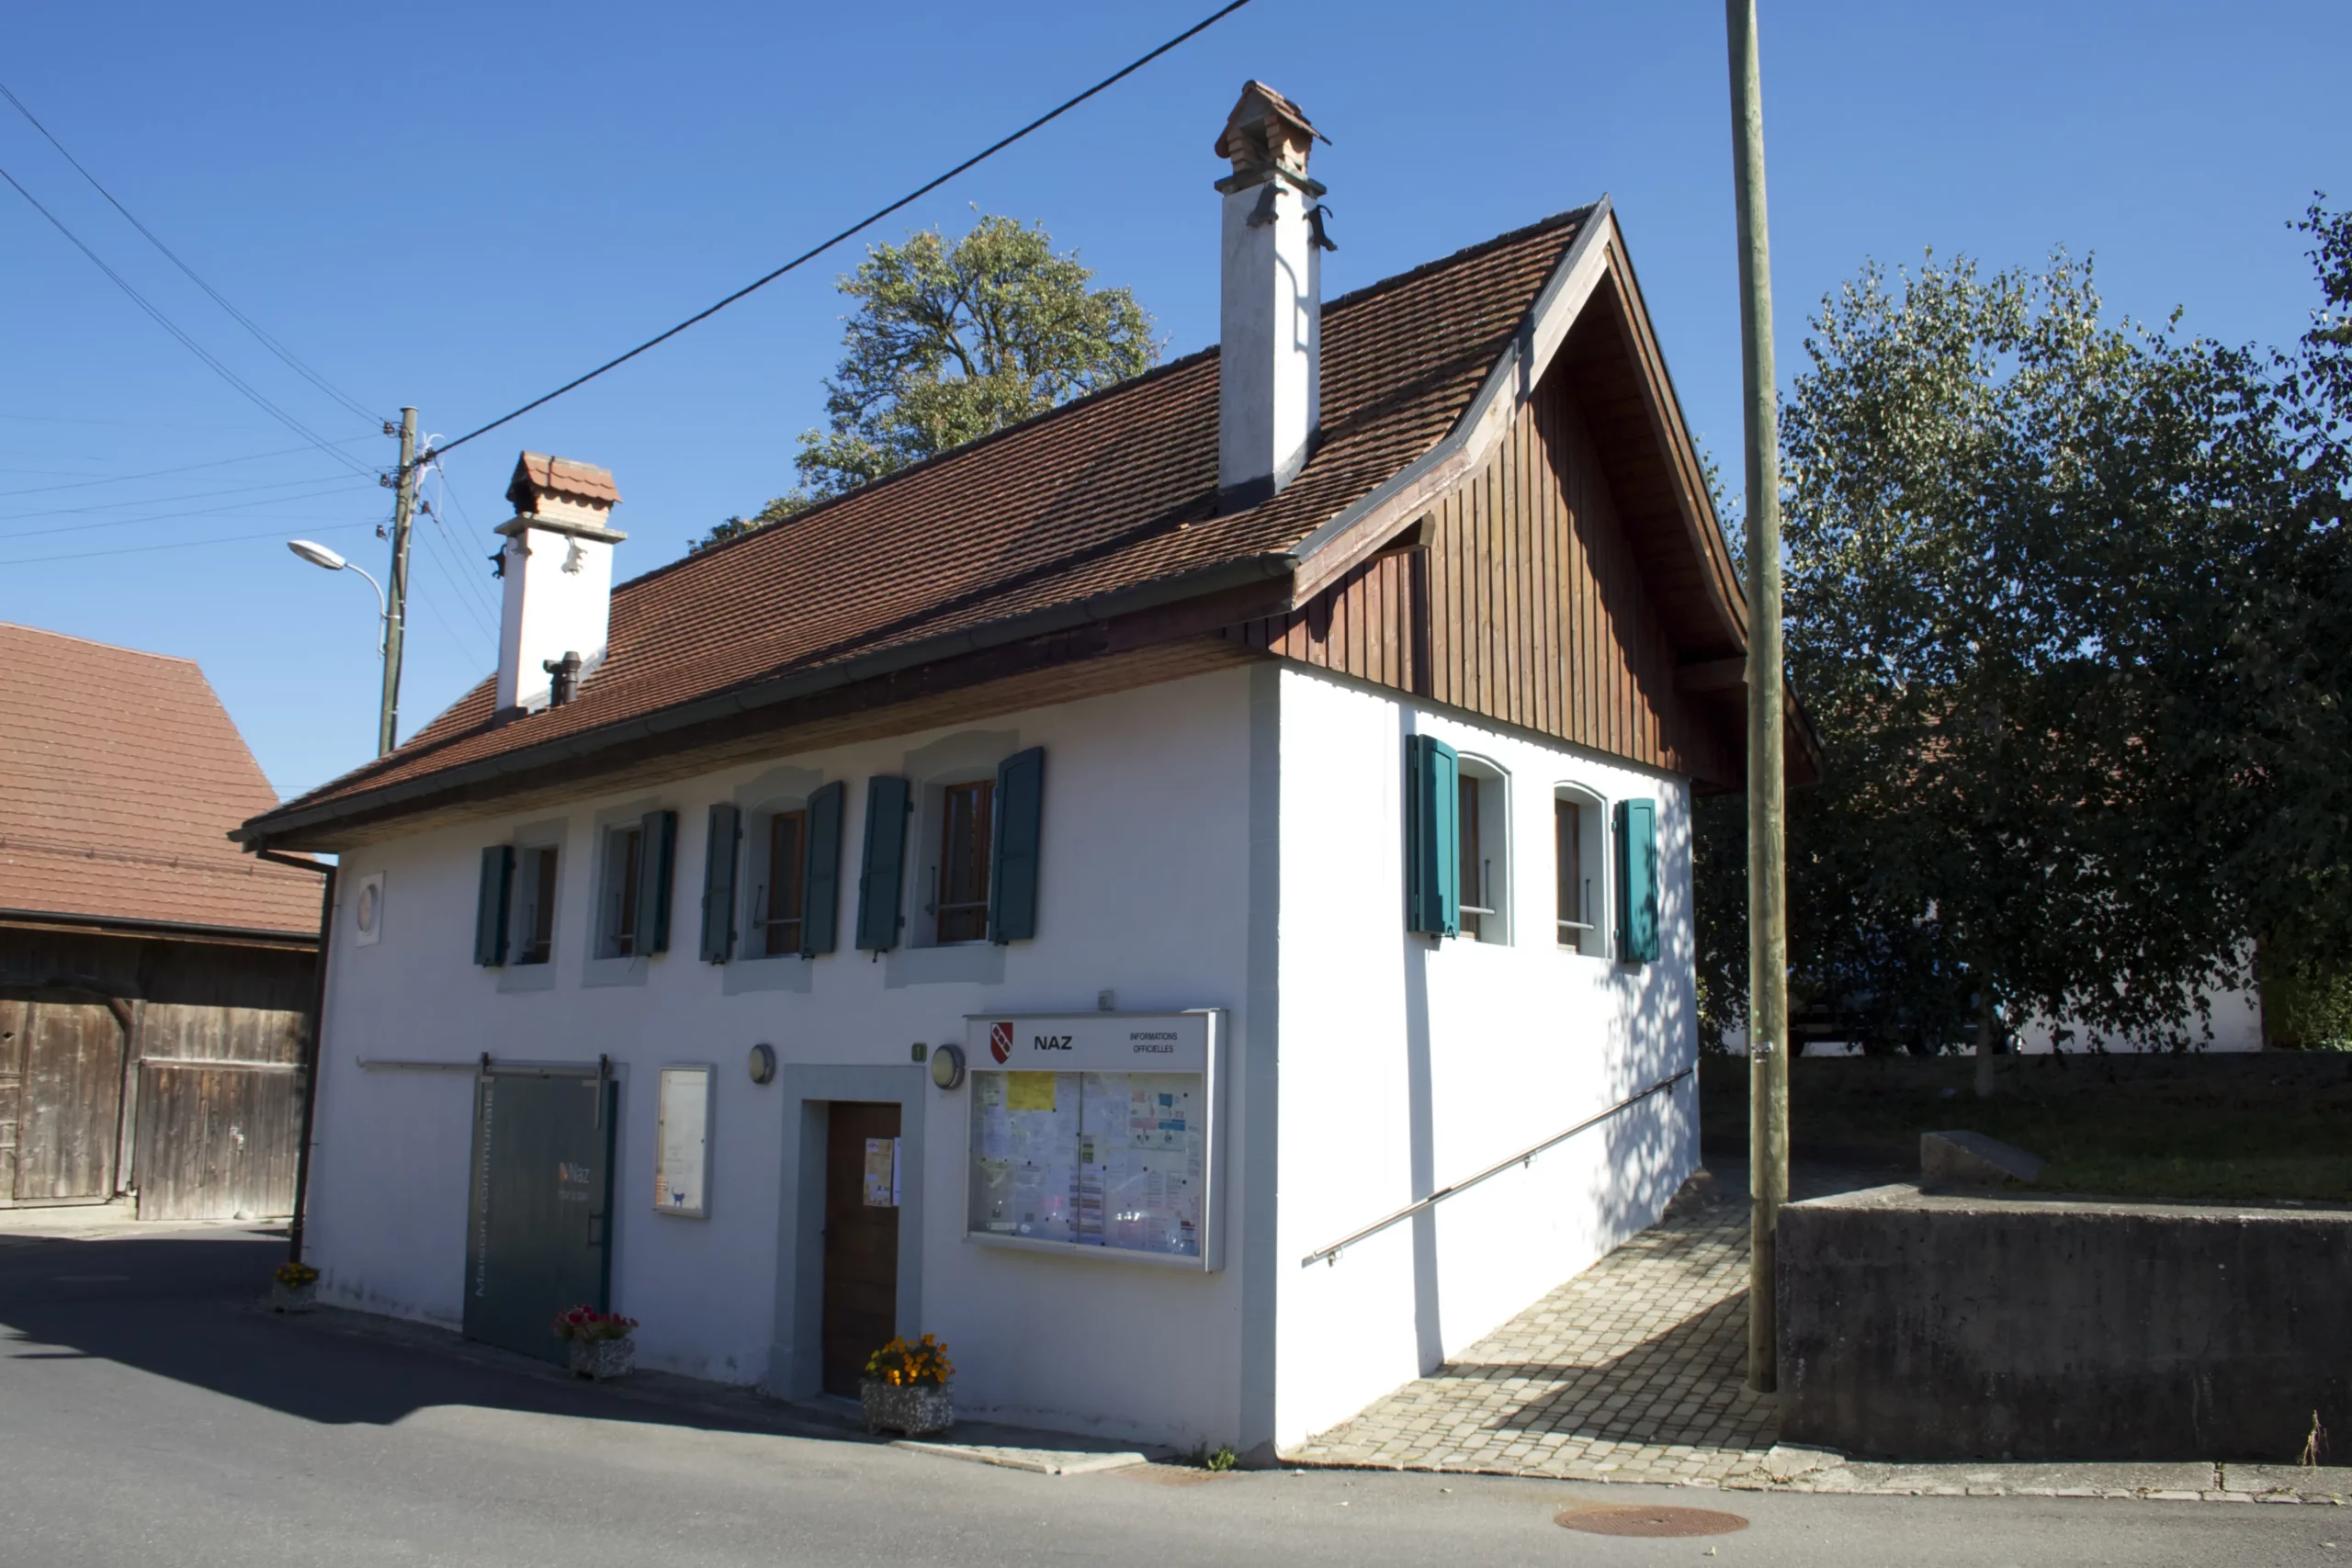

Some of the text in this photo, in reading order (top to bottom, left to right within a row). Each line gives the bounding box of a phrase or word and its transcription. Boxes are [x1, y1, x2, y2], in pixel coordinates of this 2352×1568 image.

[1034, 1035, 1073, 1051] NAZ
[1129, 1032, 1178, 1041] INFORMATIONS
[1133, 1044, 1174, 1053] OFFICIELLES
[569, 1162, 590, 1183] Naz
[475, 1089, 493, 1297] Maison communale
